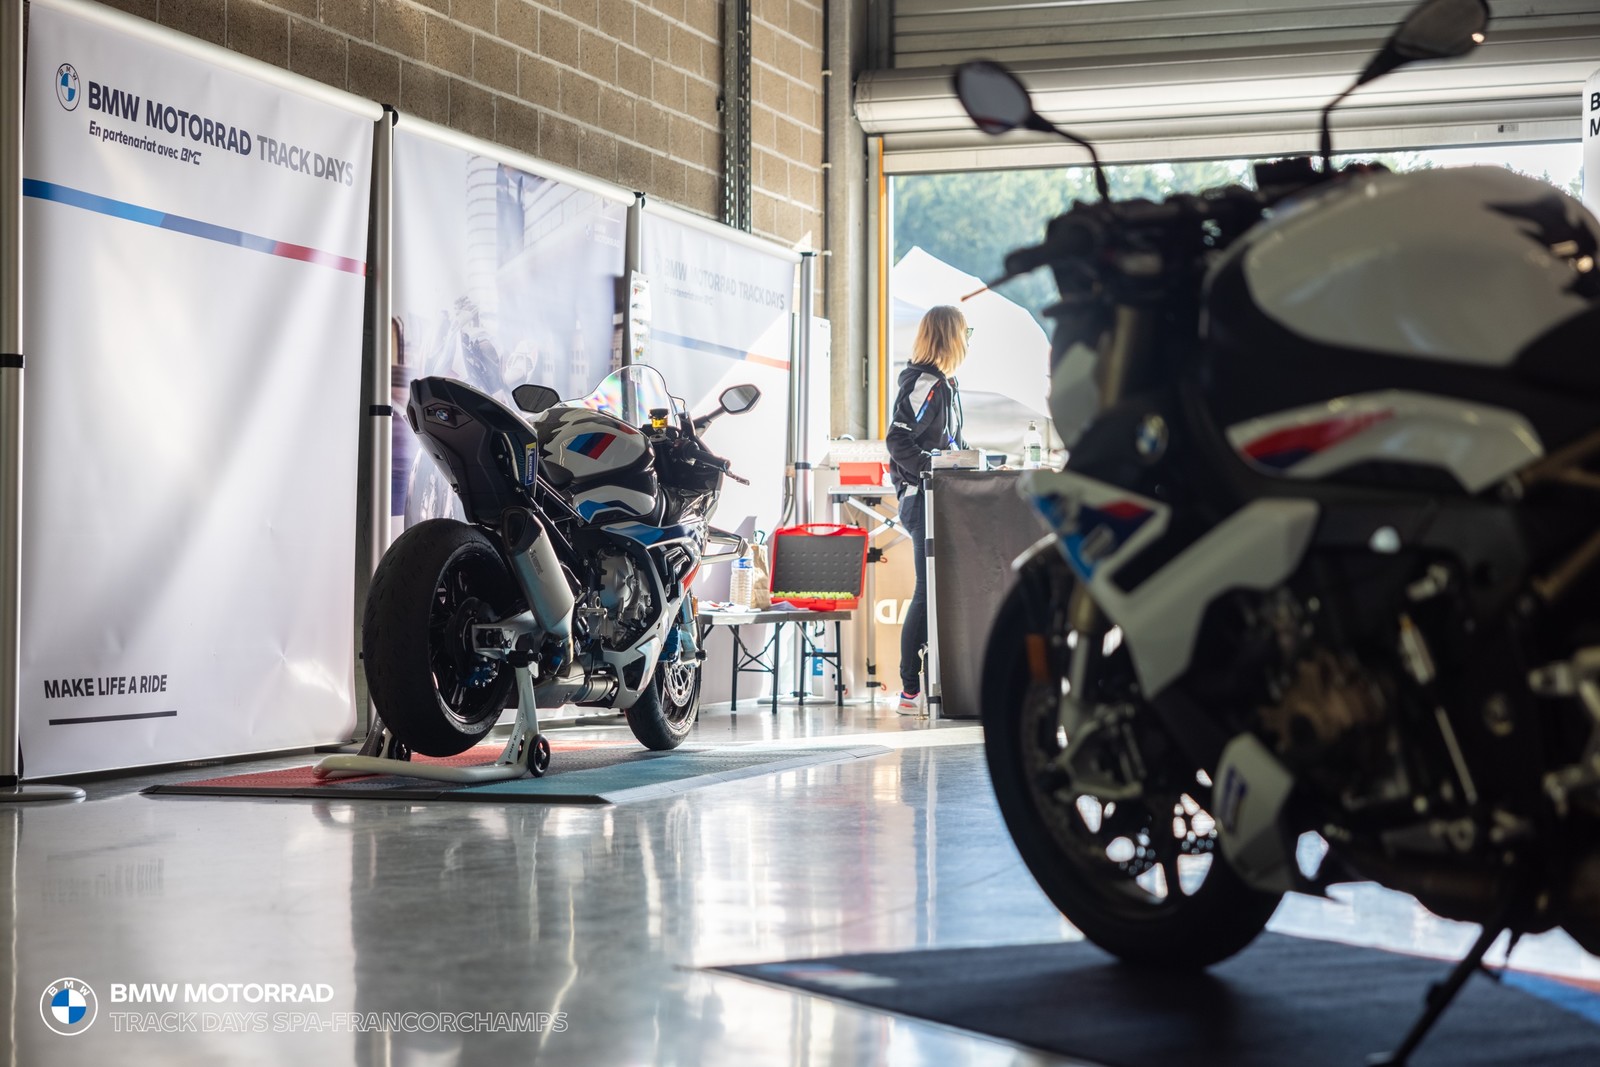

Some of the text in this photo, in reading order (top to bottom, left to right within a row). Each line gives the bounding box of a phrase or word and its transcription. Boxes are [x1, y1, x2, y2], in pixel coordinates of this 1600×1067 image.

[88, 80, 354, 187] BMW MOTORRAD TRACK DAYS
[89, 120, 101, 137] En
[102, 128, 157, 153] partenariat
[157, 144, 179, 160] avec
[738, 281, 765, 305] TRACK
[765, 289, 785, 310] DAYS
[44, 674, 167, 699] MAKE LIFE A RIDE
